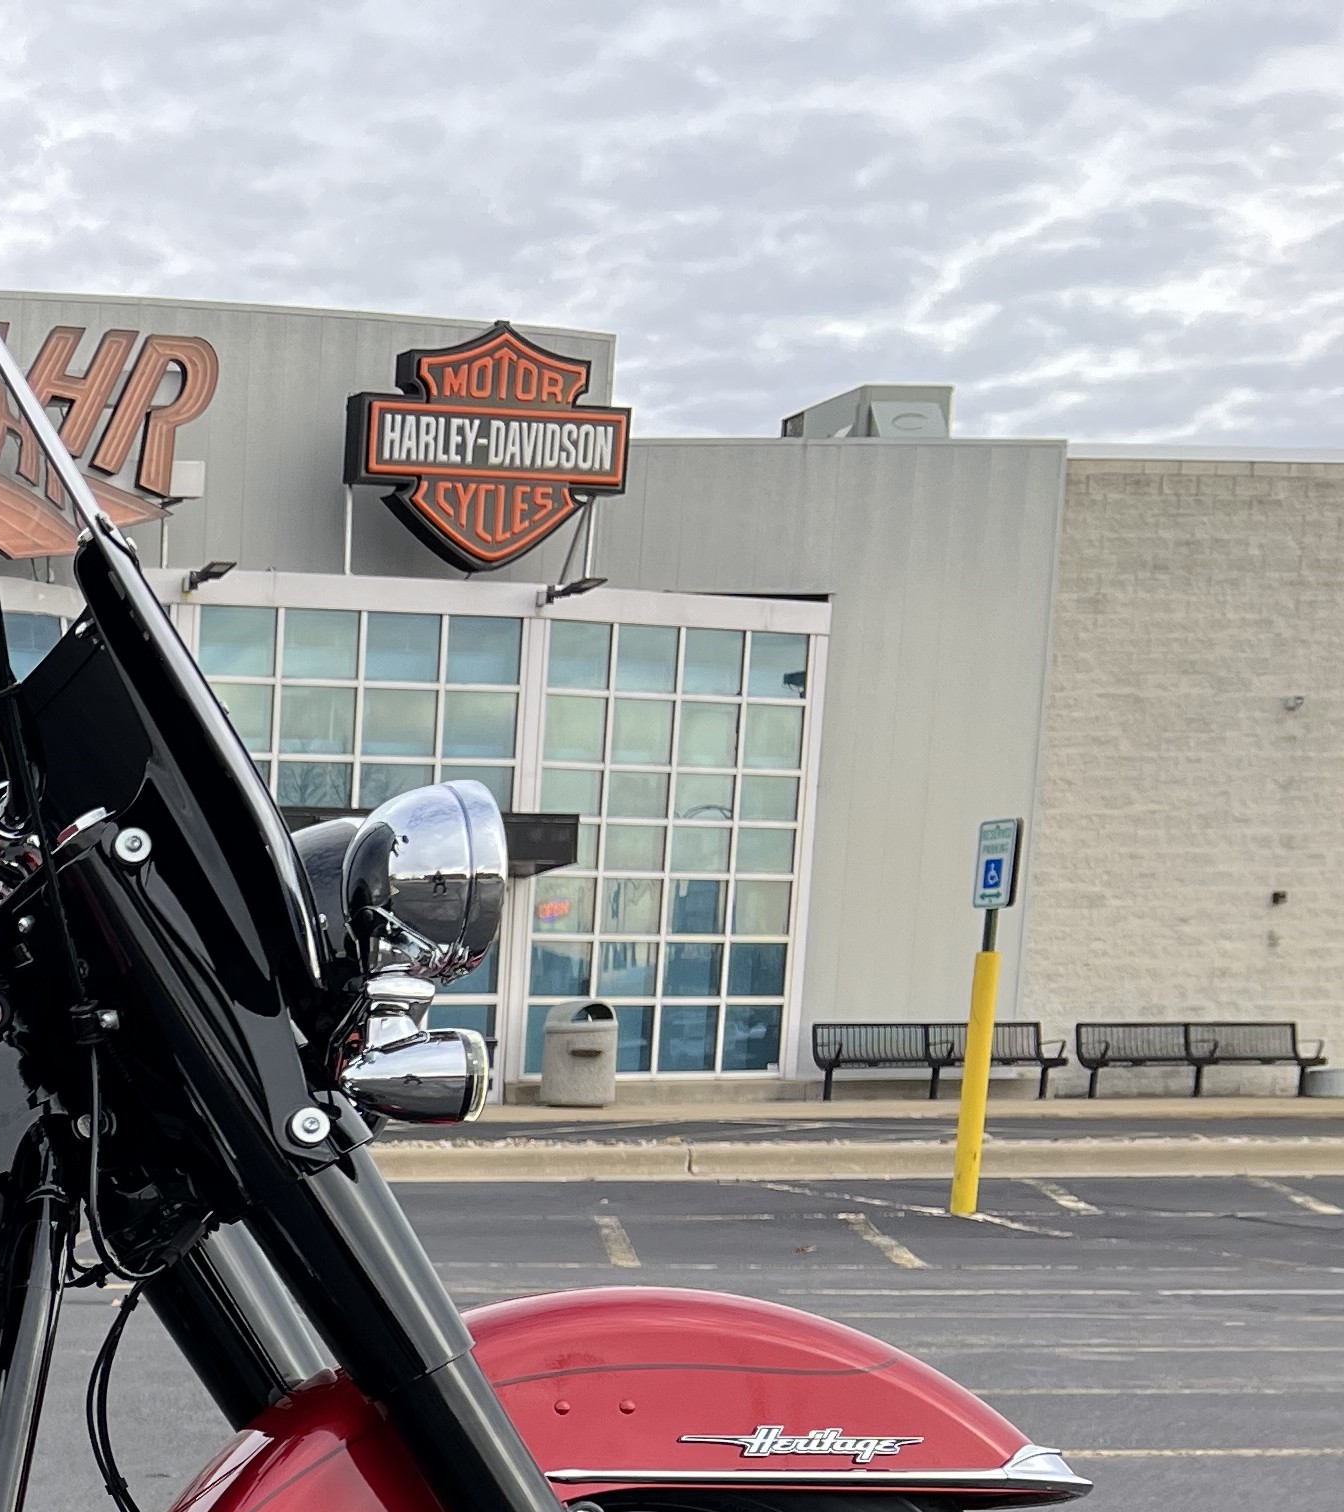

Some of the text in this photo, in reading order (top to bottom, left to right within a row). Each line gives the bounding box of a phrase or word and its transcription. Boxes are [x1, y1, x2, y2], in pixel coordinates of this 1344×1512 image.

[443, 348, 563, 404] MOTOR
[382, 413, 613, 471] HARLEY-DAVIDSON
[435, 481, 552, 544] CYCLES
[742, 1425, 901, 1463] Heritage
